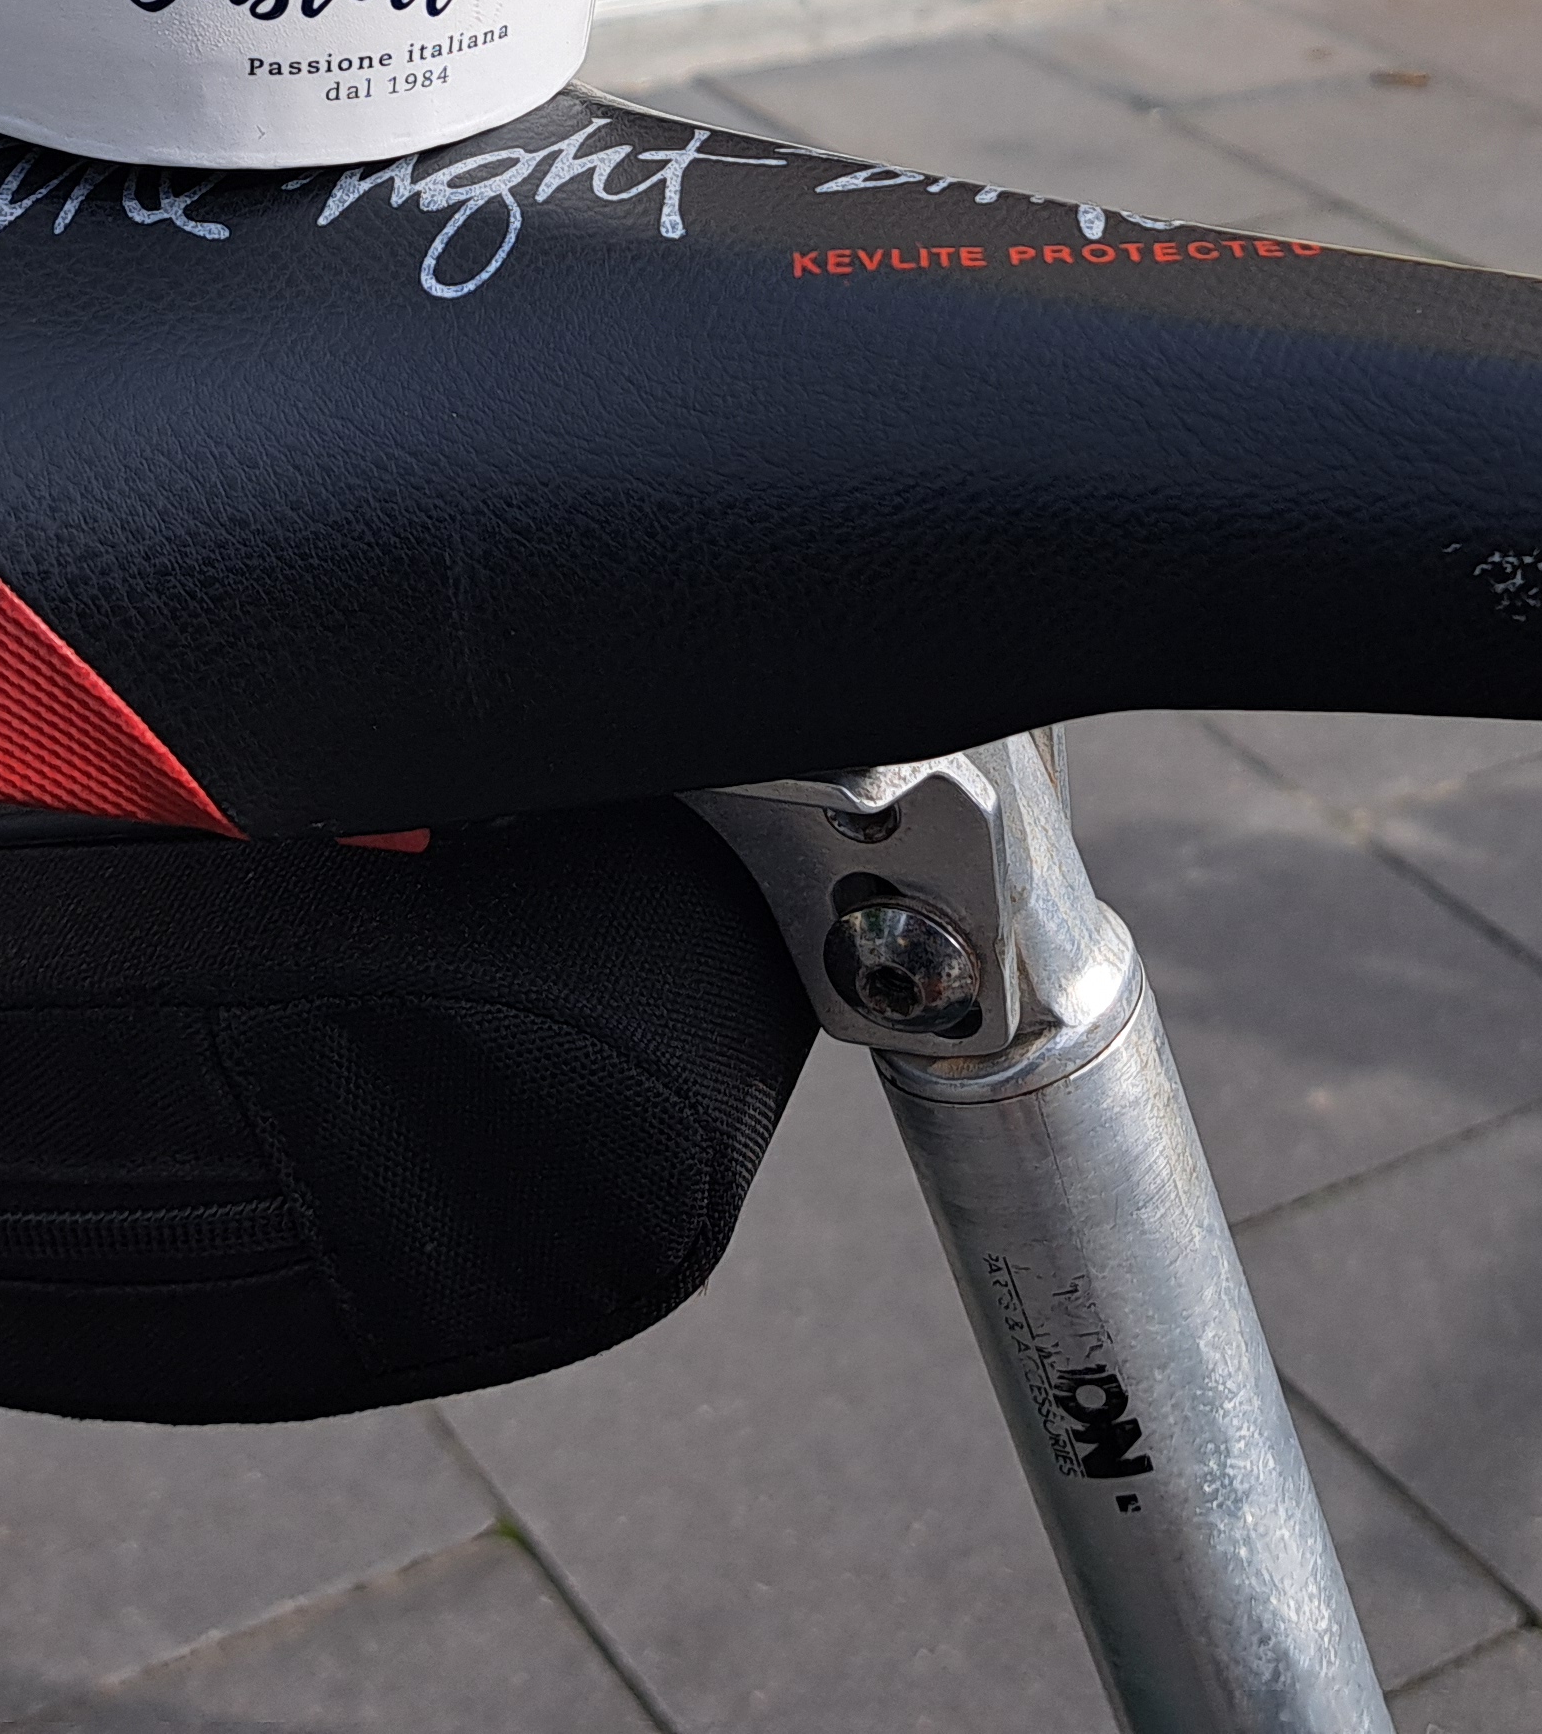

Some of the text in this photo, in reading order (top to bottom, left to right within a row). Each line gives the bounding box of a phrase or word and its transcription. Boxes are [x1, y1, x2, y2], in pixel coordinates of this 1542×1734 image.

[246, 24, 511, 77] Passione italiana
[324, 65, 451, 103] dal 1984
[792, 243, 988, 279] KEVLITE
